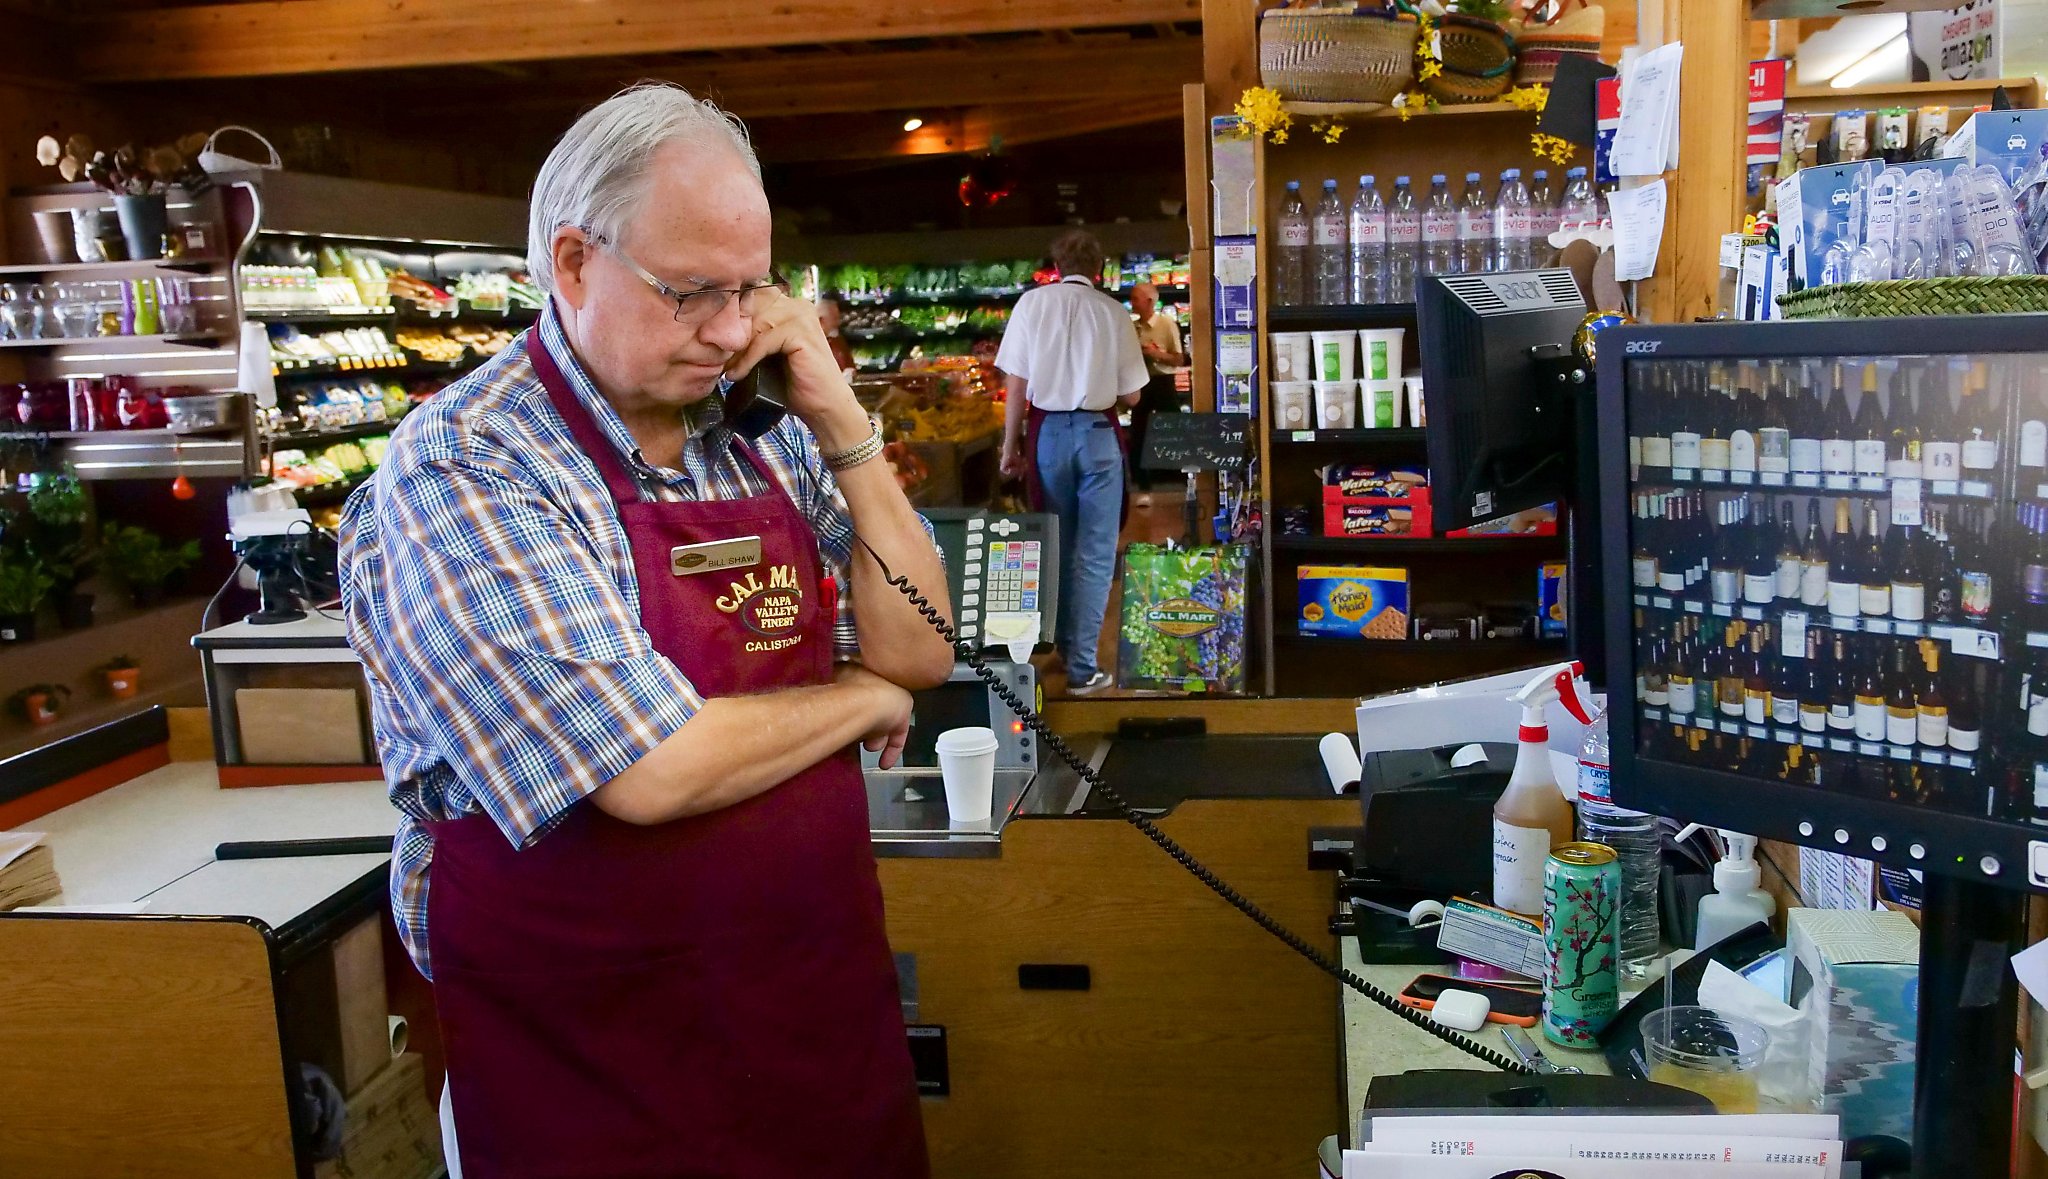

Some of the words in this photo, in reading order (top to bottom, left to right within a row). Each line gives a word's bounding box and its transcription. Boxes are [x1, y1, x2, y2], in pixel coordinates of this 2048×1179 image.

[1941, 33, 1992, 70] amazon
[1499, 280, 1541, 300] acer
[1625, 340, 1662, 353] acer
[1340, 478, 1384, 491] Wafers
[708, 557, 726, 568] BILL
[728, 554, 755, 565] SHAW
[715, 572, 764, 614] CAL
[769, 565, 803, 599] MA
[764, 596, 792, 607] NAPA
[1331, 591, 1368, 605] Honey
[755, 605, 799, 619] VALLEY'S
[1338, 601, 1365, 613] Maid
[761, 617, 795, 629] FINEST
[1149, 611, 1175, 620] CAL
[1178, 612, 1215, 621] MART
[1571, 988, 1611, 1002] Green
